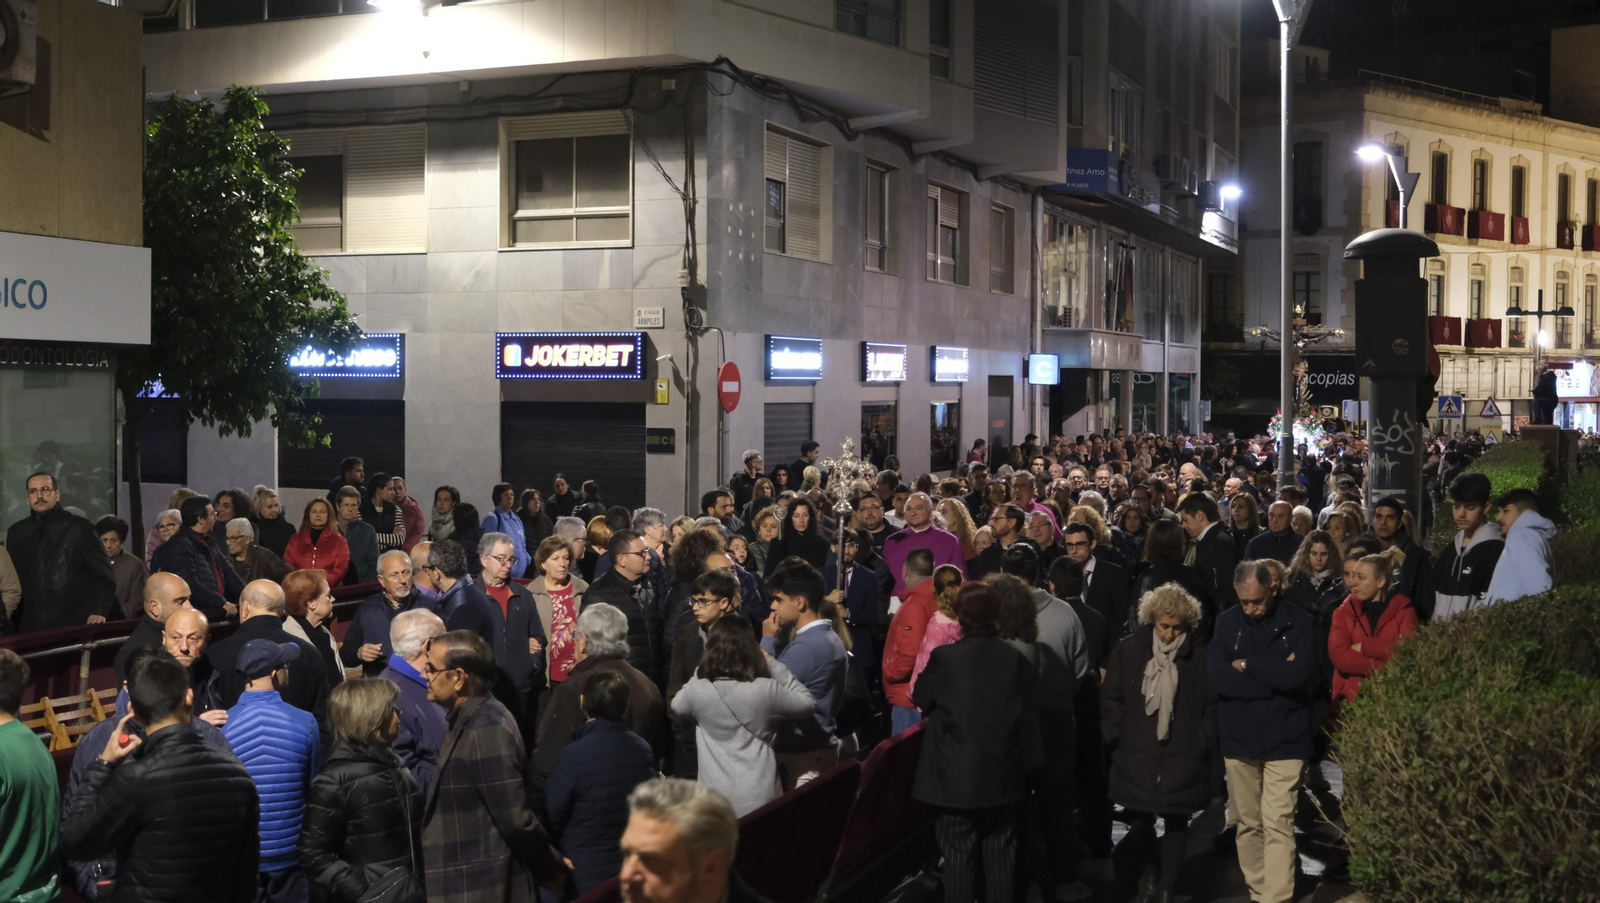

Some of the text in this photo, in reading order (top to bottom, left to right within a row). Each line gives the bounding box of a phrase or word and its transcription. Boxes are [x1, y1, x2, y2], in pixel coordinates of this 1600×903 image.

[1086, 167, 1106, 176] Amo
[0, 277, 48, 310] ICO
[637, 317, 661, 326] ARAPILES
[524, 344, 634, 367] JOKERBET
[1035, 360, 1052, 378] C
[661, 436, 669, 446] C
